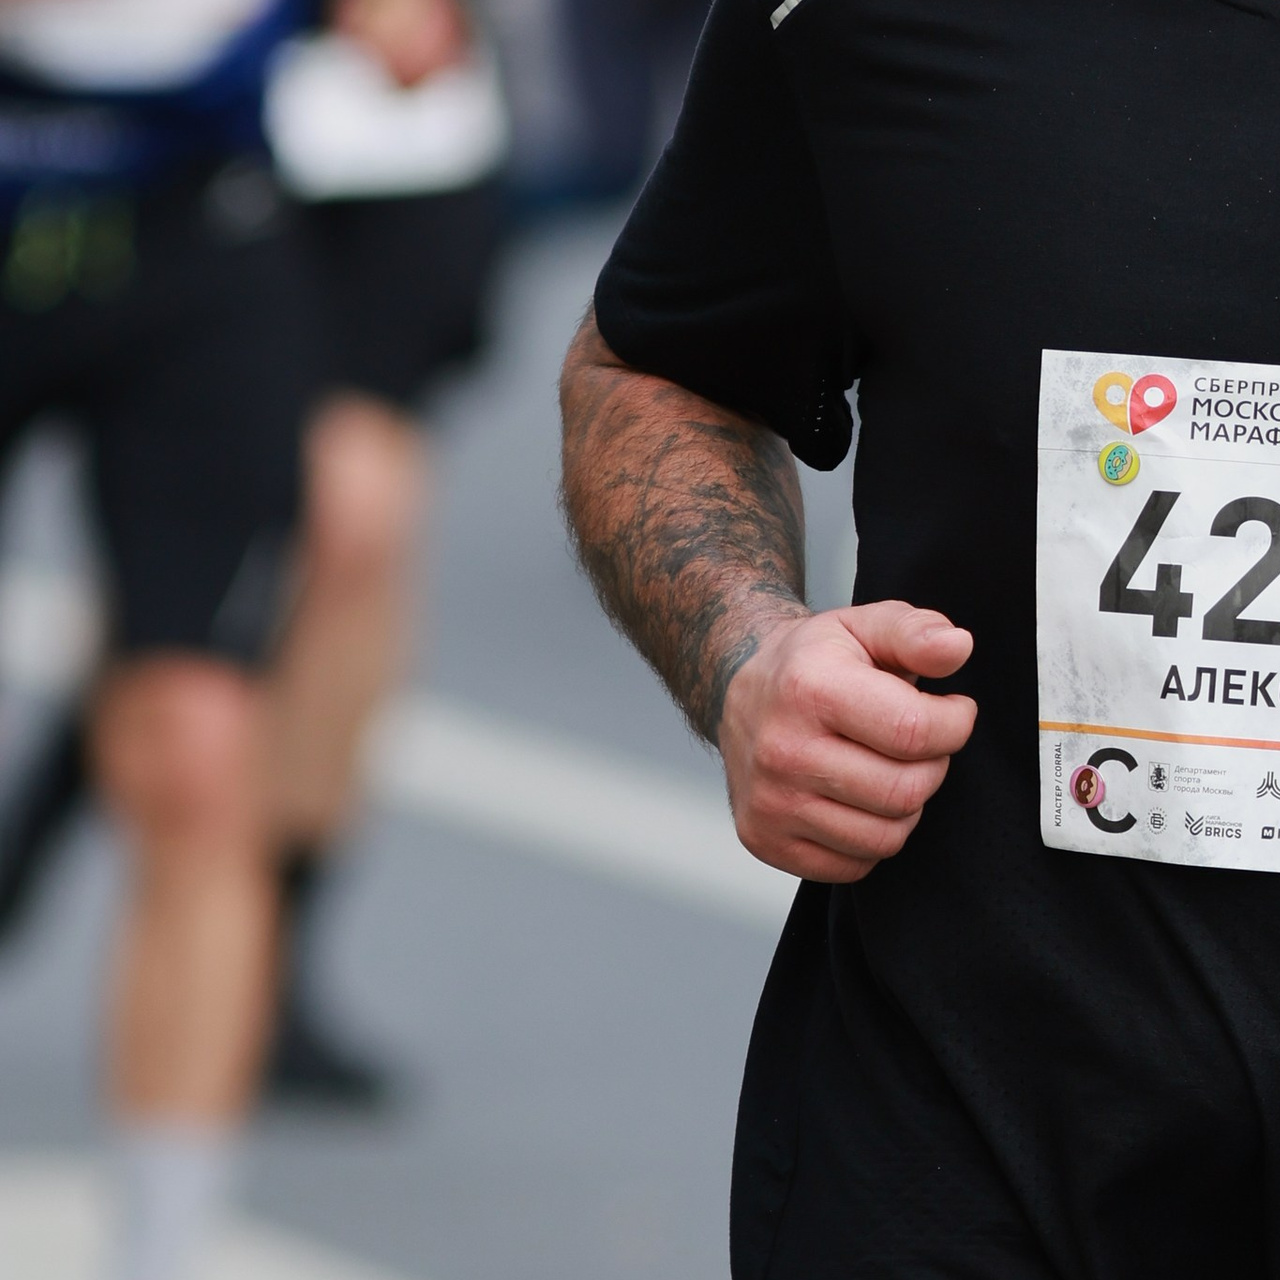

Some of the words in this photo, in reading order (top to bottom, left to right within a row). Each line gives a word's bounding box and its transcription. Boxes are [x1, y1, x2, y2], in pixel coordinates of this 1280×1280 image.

[1054, 742, 1063, 778] CORRAL
[1054, 785, 1063, 827] КЛАСТЕР
[1204, 826, 1242, 839] BRICS
